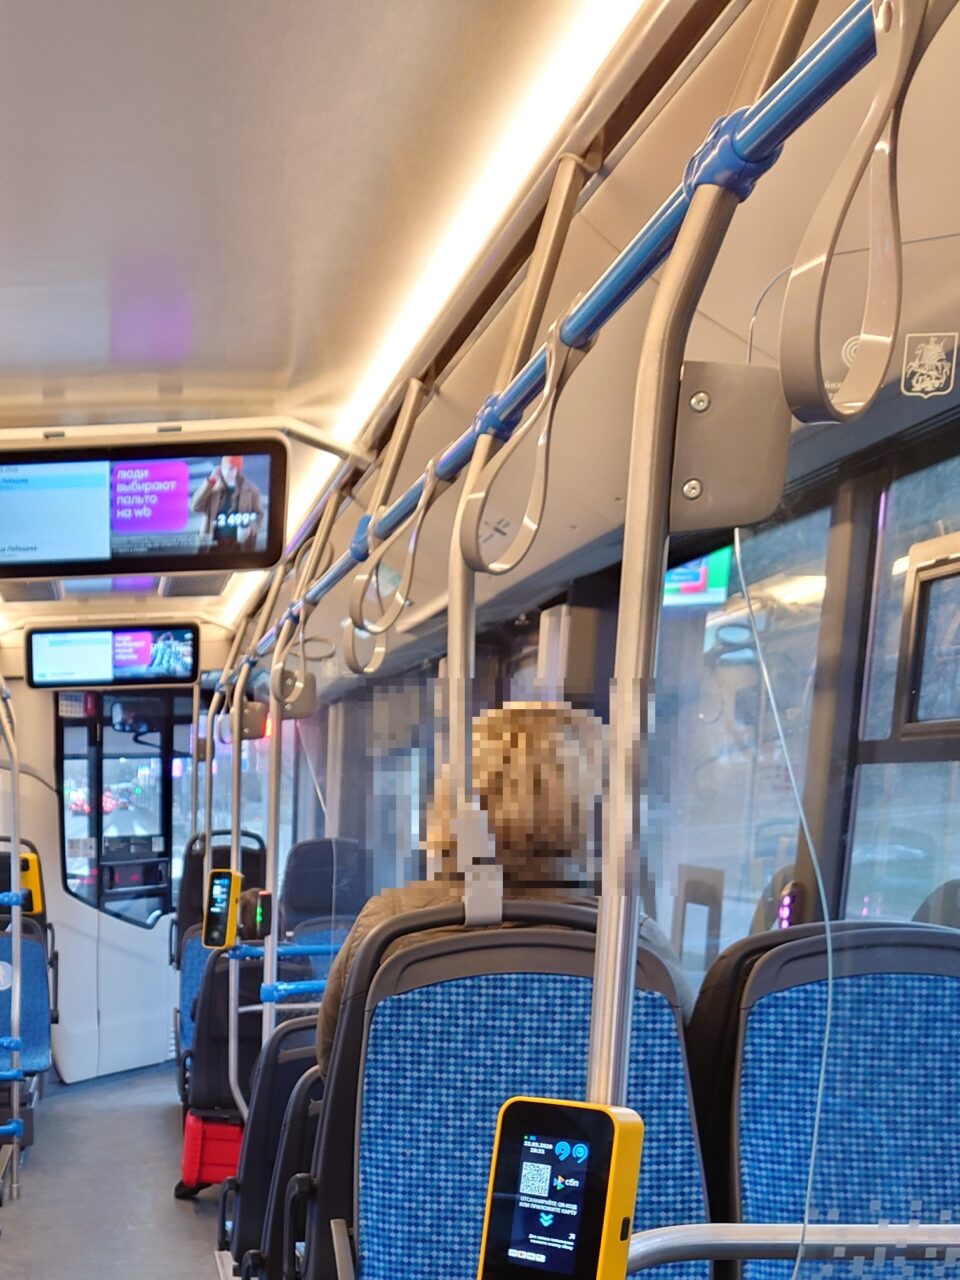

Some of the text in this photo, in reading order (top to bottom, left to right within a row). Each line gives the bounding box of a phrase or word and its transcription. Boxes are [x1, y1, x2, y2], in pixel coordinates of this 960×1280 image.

[116, 468, 149, 481] люди
[116, 480, 177, 494] выбирают
[116, 494, 158, 505] пальто
[116, 506, 152, 518] на wb
[565, 1178, 579, 1187] сбп
